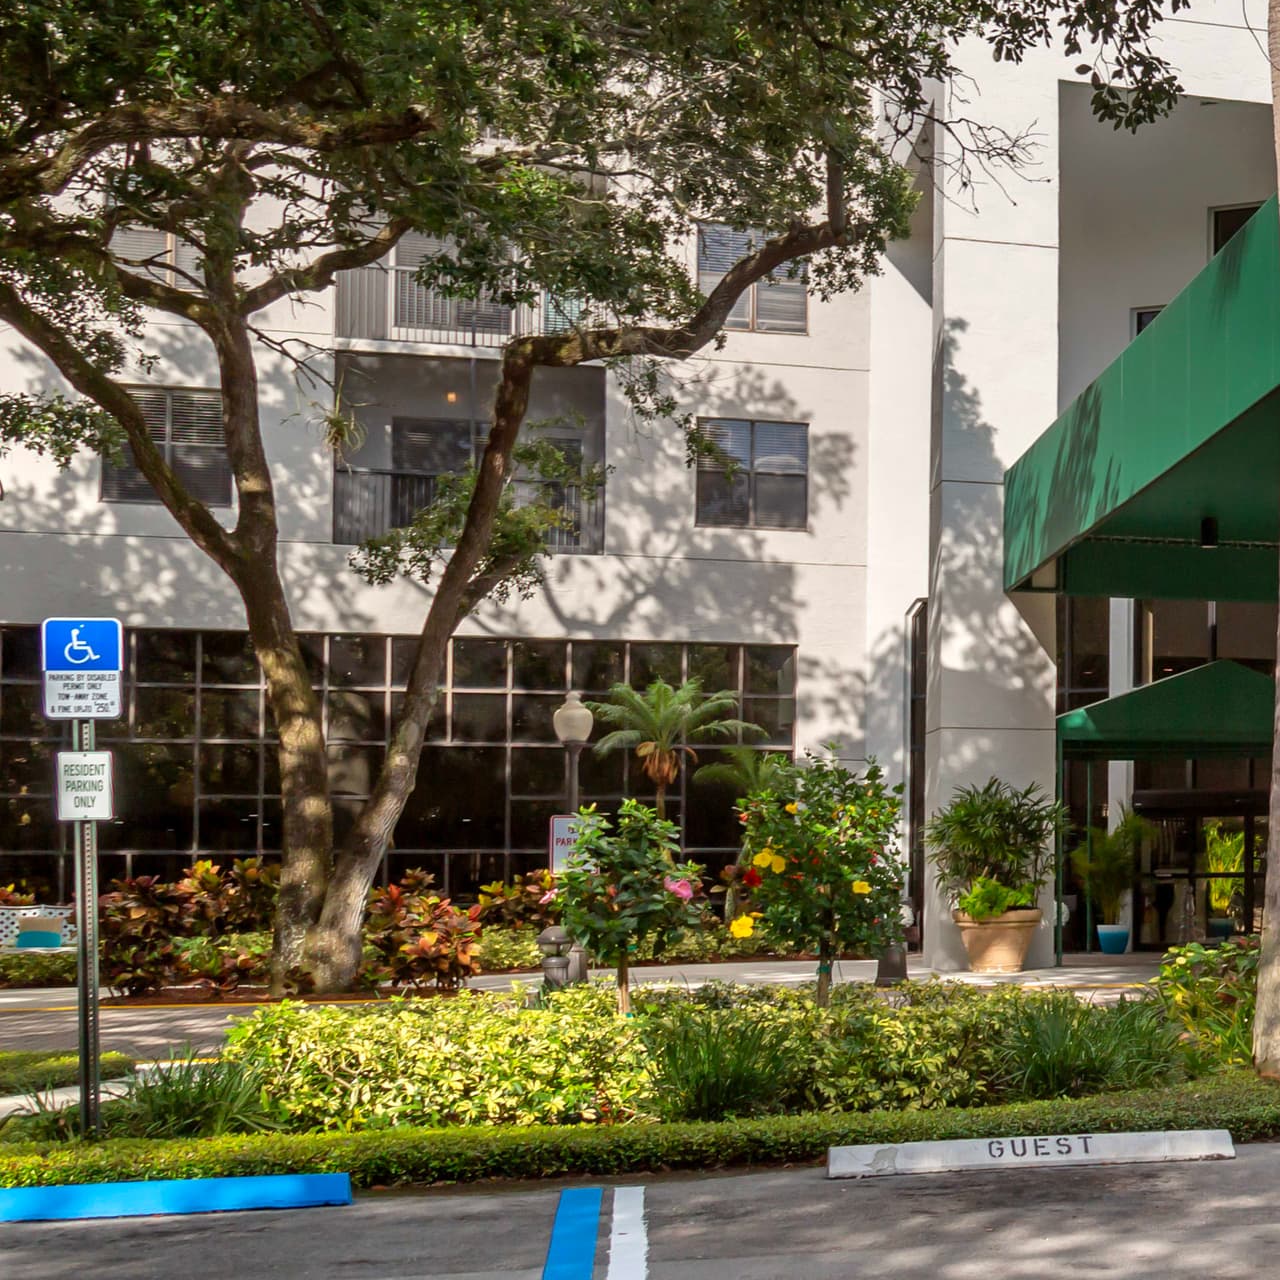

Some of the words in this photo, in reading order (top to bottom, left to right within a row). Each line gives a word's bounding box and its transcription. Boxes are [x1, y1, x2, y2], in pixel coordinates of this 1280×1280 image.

[63, 763, 106, 776] RESIDENT
[65, 779, 104, 793] PARKING
[73, 795, 97, 808] ONLY
[987, 1135, 1093, 1158] GUEST
